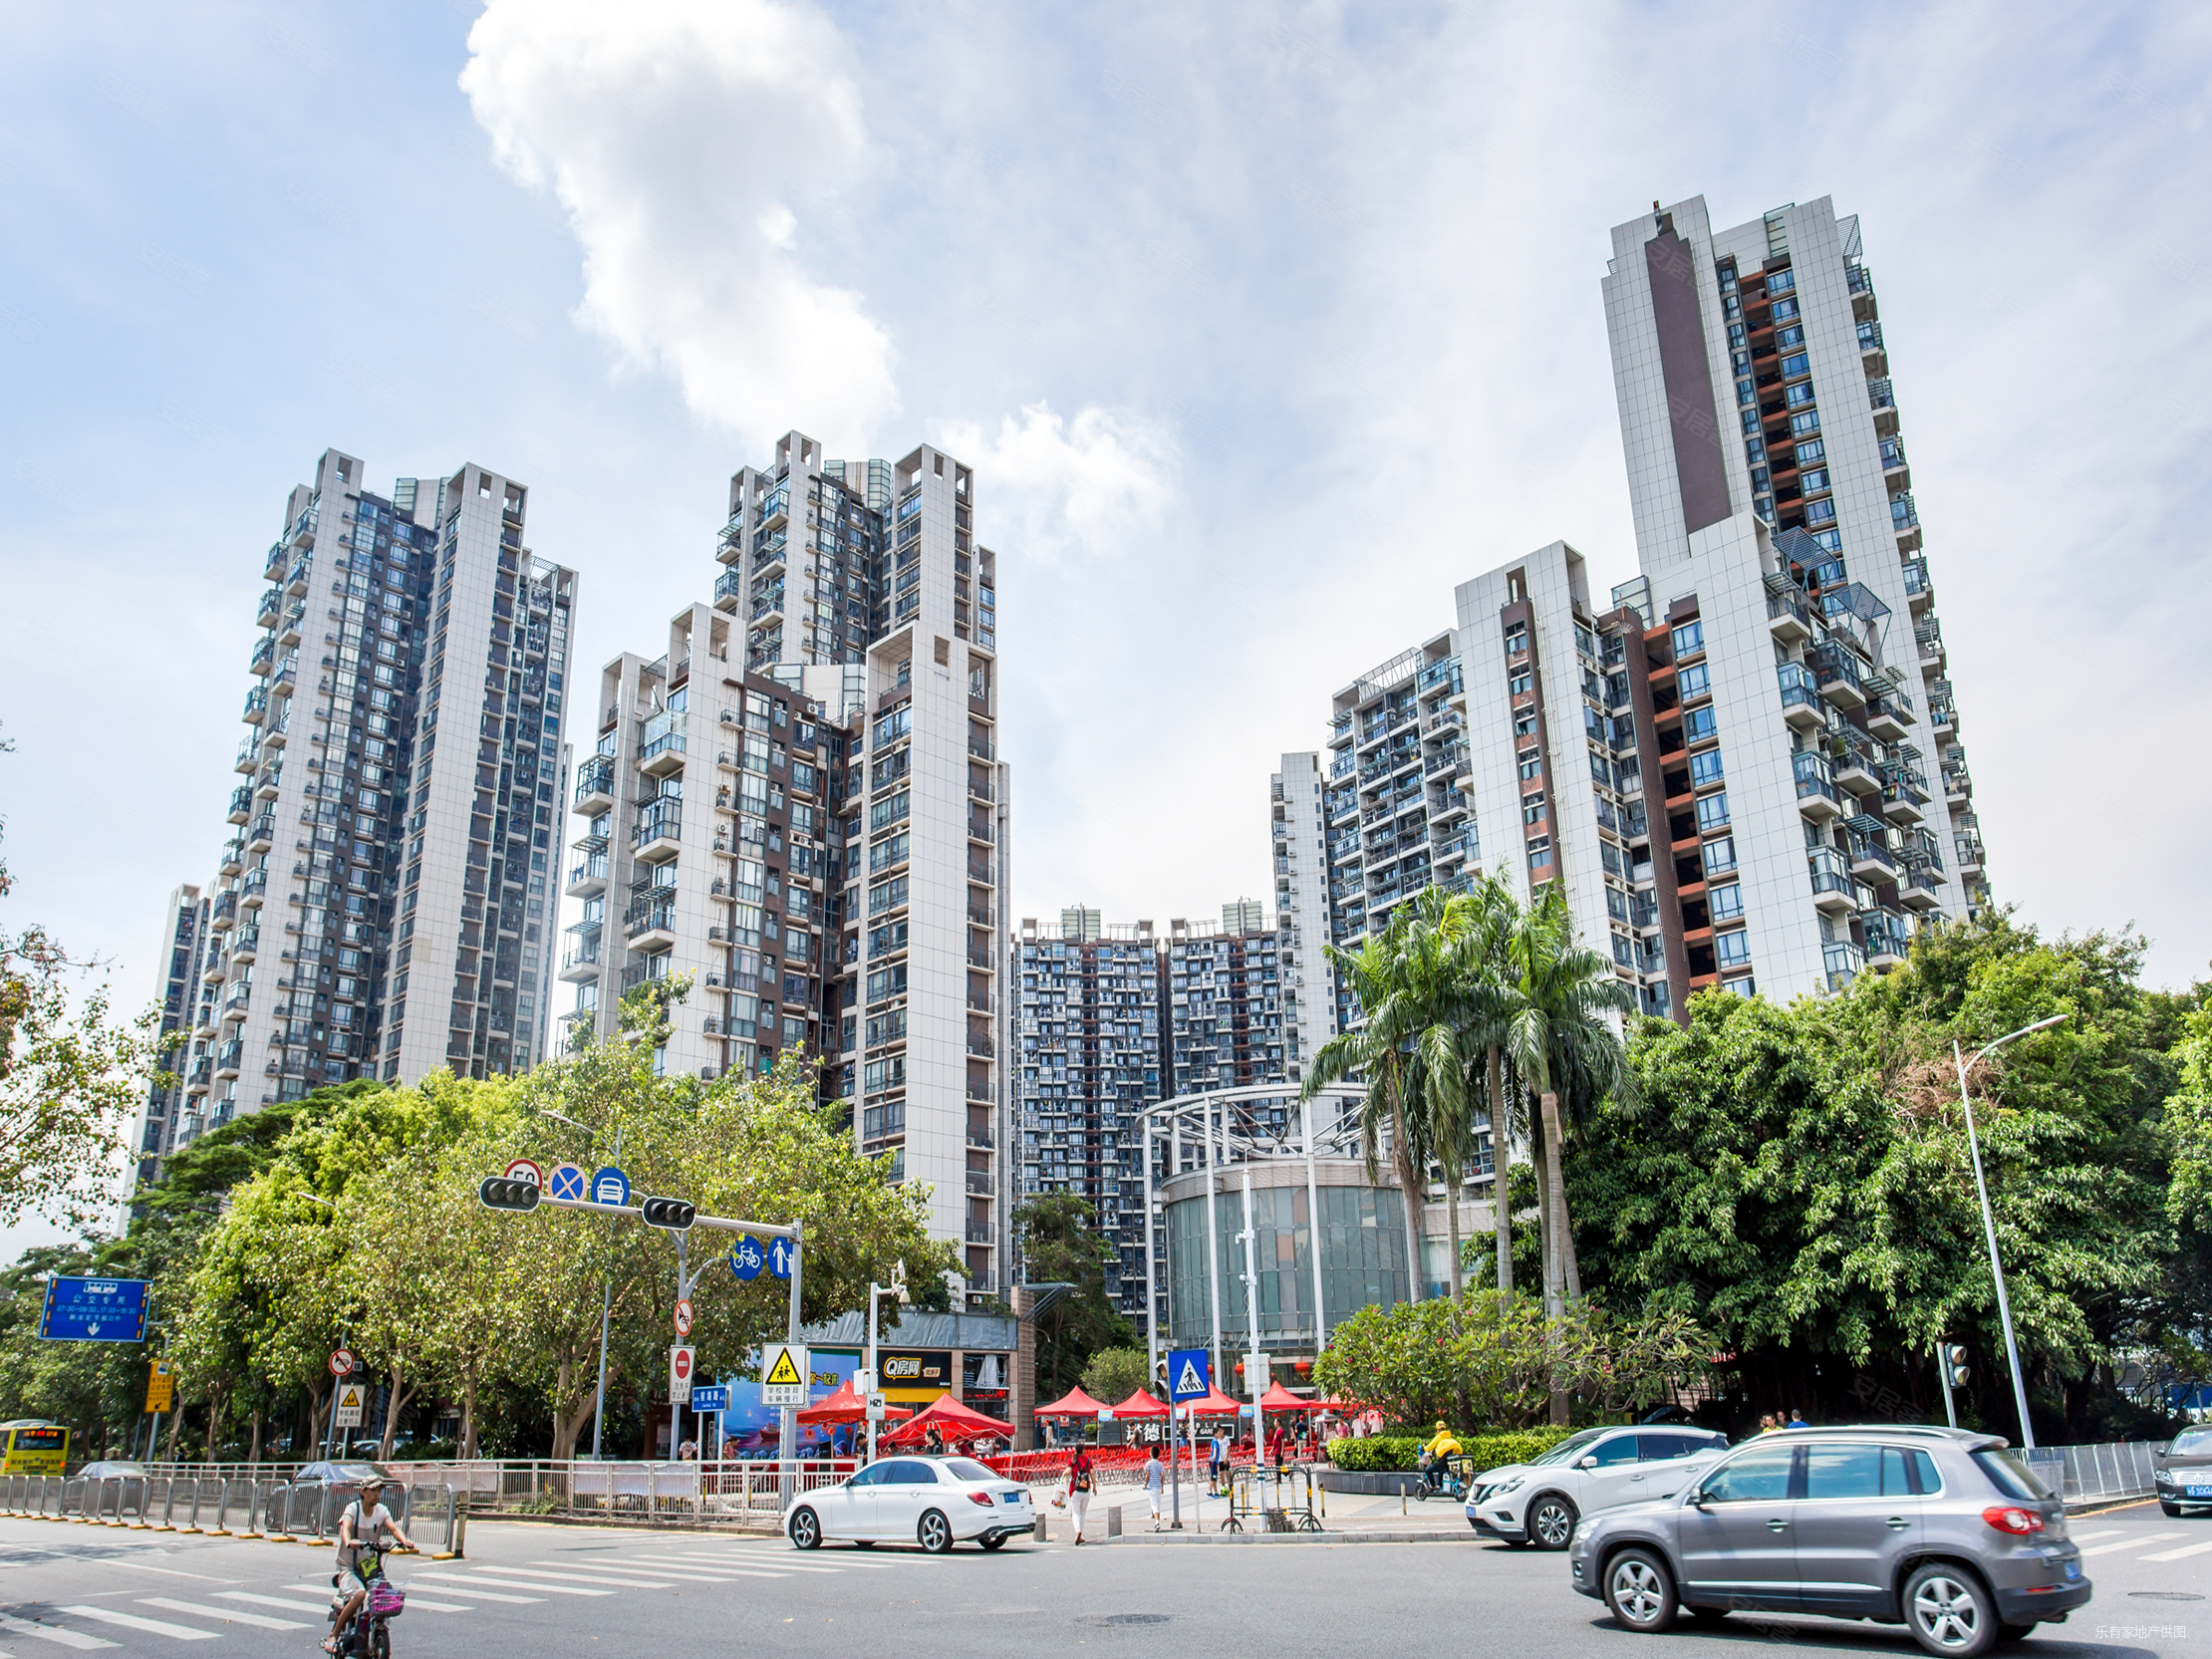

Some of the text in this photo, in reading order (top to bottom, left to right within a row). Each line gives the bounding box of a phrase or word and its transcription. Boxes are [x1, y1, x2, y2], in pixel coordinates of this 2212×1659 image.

[73, 1293, 126, 1305] 公交专用
[886, 1359, 920, 1376] Q房网
[768, 1386, 798, 1395] 学校路段
